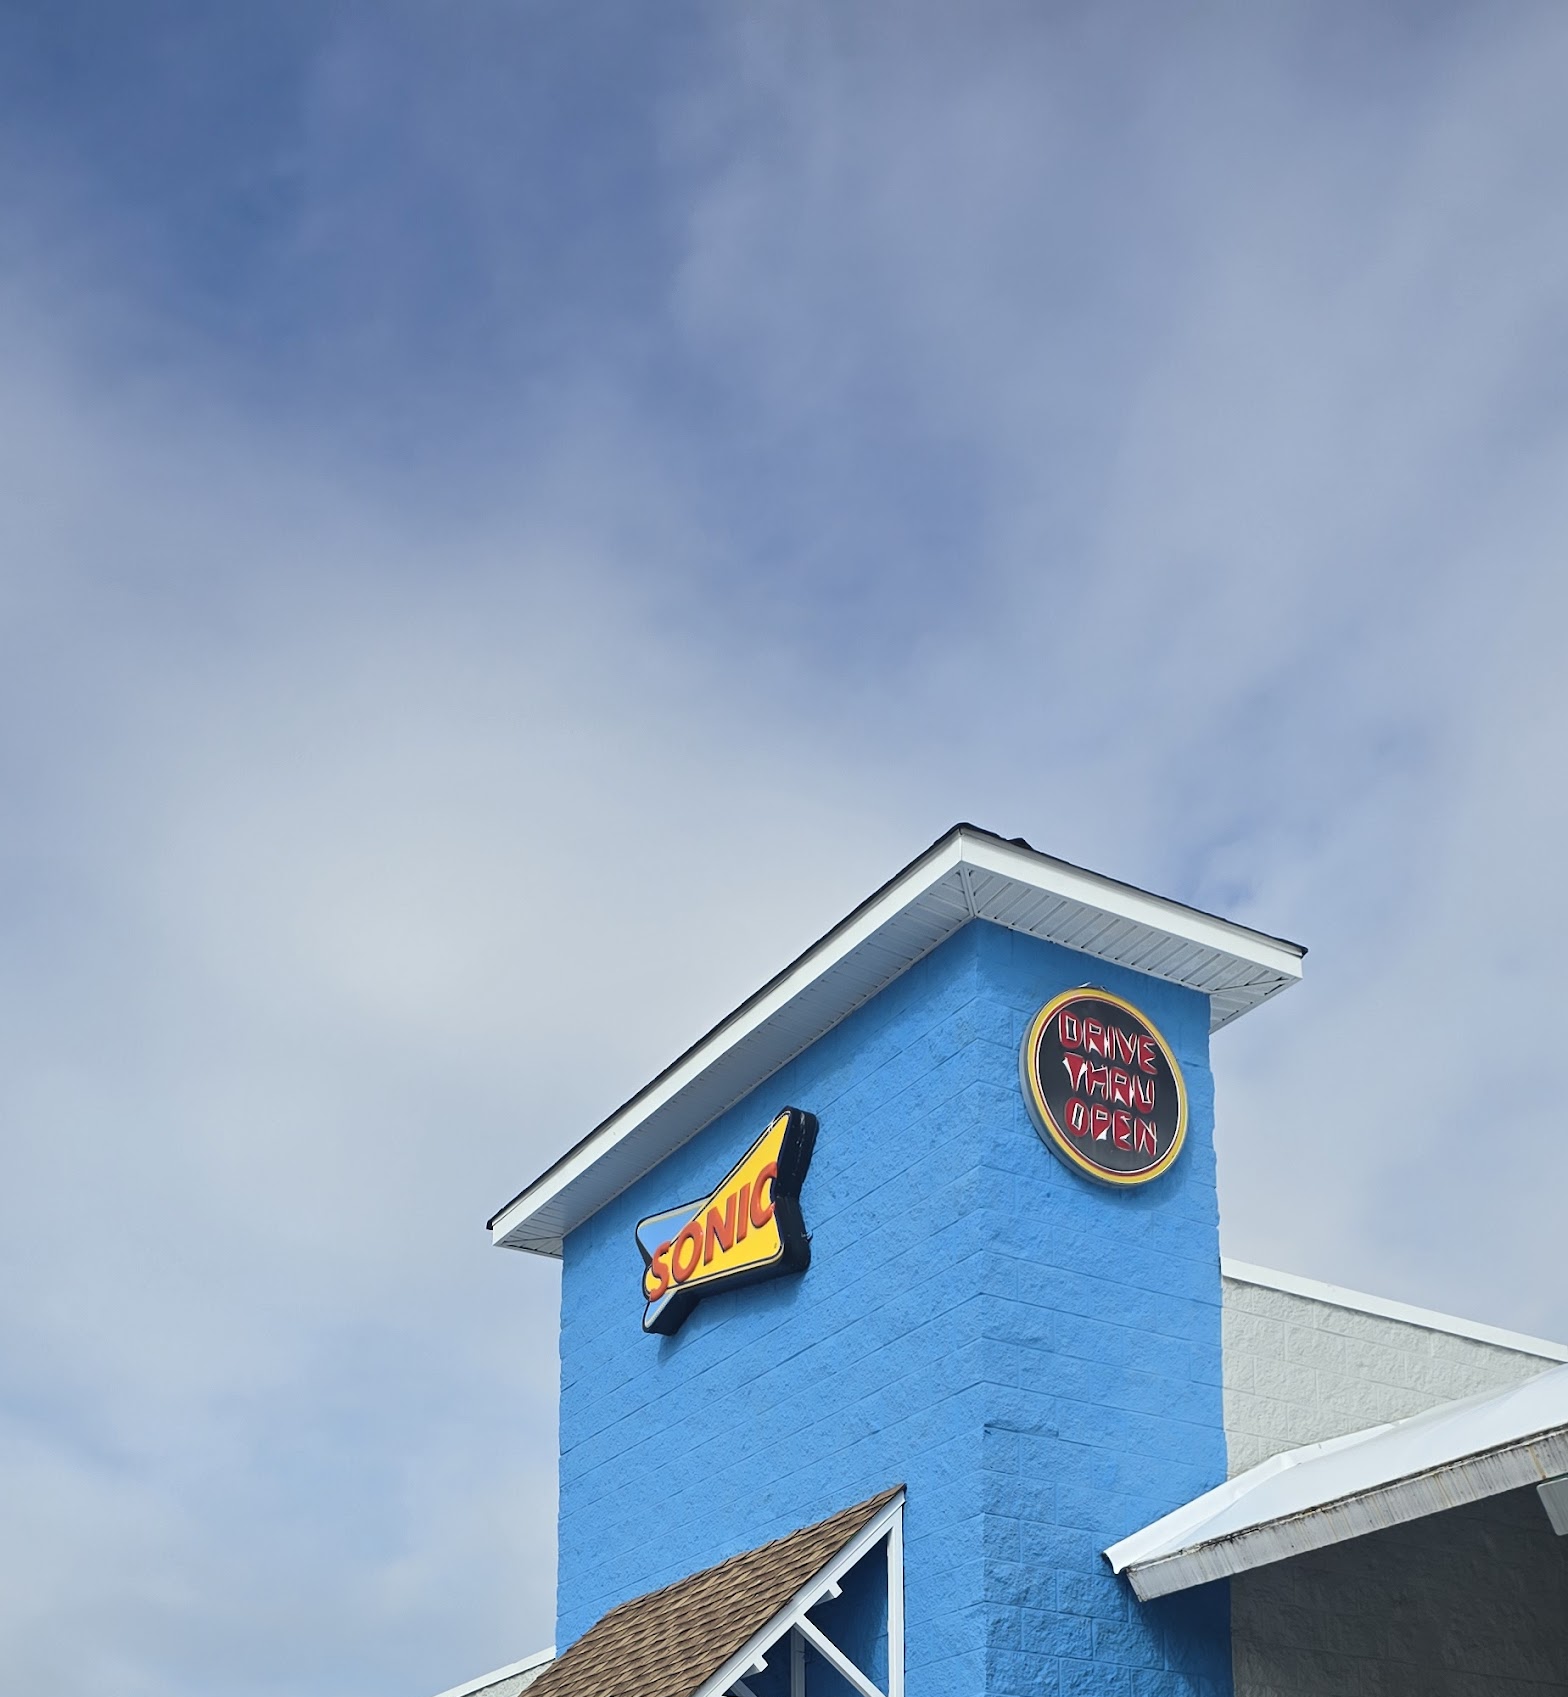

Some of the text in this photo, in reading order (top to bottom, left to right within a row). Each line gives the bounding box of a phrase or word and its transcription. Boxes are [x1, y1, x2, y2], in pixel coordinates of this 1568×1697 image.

[1059, 1011, 1158, 1075] DRIVE
[1062, 1052, 1155, 1114] THRU
[1064, 1097, 1157, 1158] OPEN
[650, 1161, 777, 1302] SONIC
